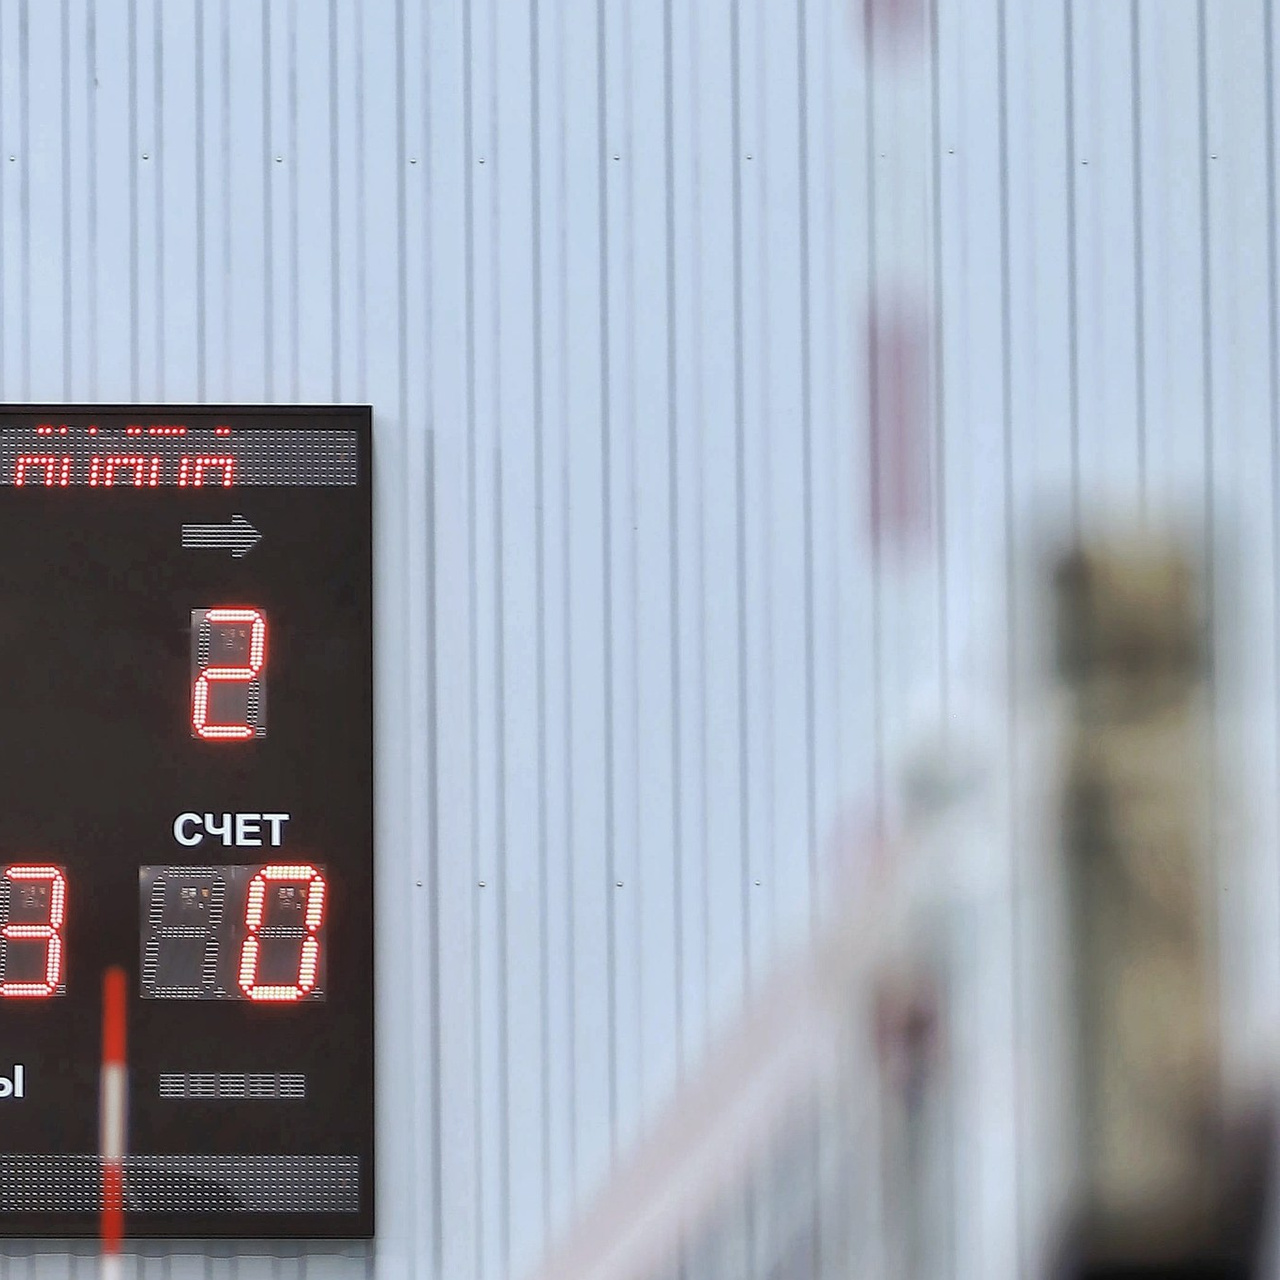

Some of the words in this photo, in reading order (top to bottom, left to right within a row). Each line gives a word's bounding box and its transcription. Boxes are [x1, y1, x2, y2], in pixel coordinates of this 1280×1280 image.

[192, 608, 266, 741] 2
[173, 812, 290, 846] СЧЕТ
[238, 865, 326, 1002] 0
